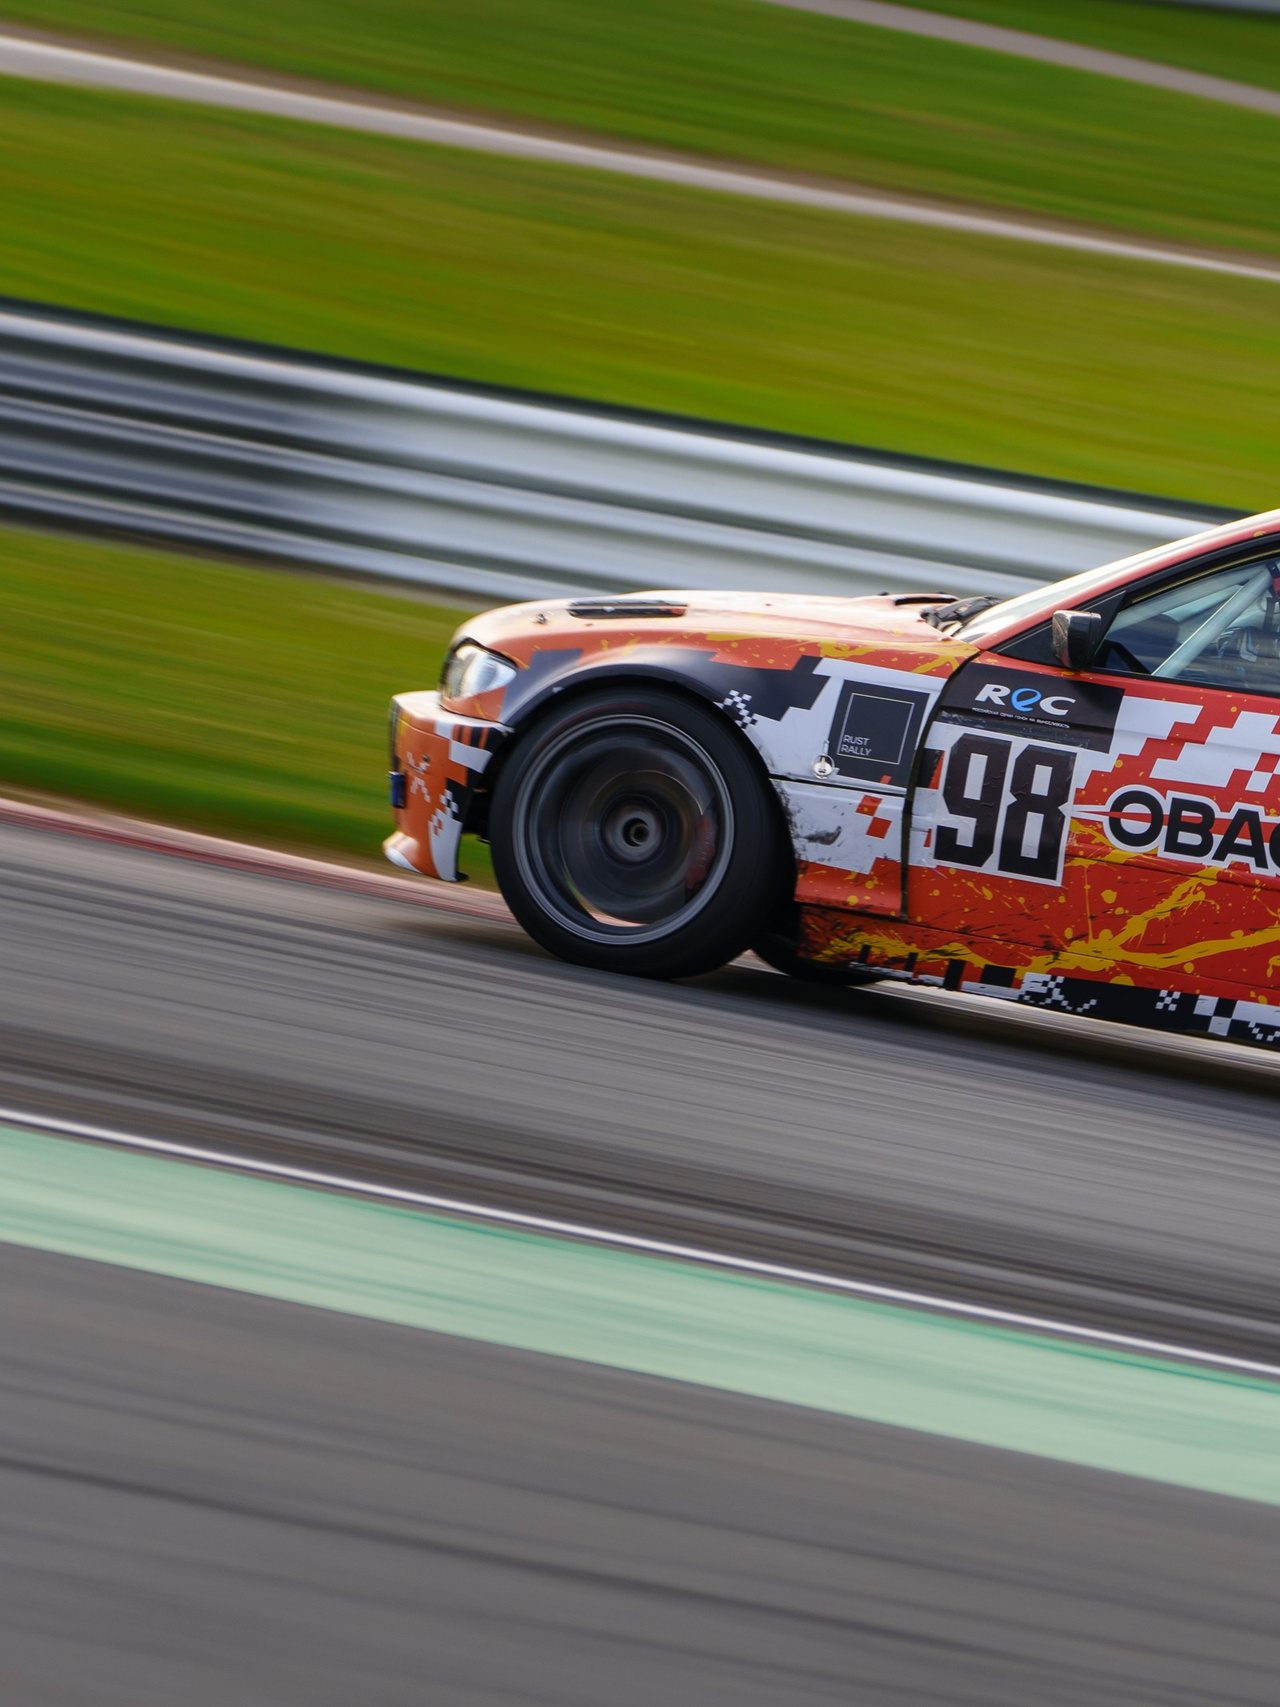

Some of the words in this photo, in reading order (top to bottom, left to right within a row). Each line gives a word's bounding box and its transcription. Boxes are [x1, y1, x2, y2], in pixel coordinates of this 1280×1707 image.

[843, 734, 870, 746] RUST
[840, 744, 872, 757] RALLY
[933, 733, 1077, 881] 98
